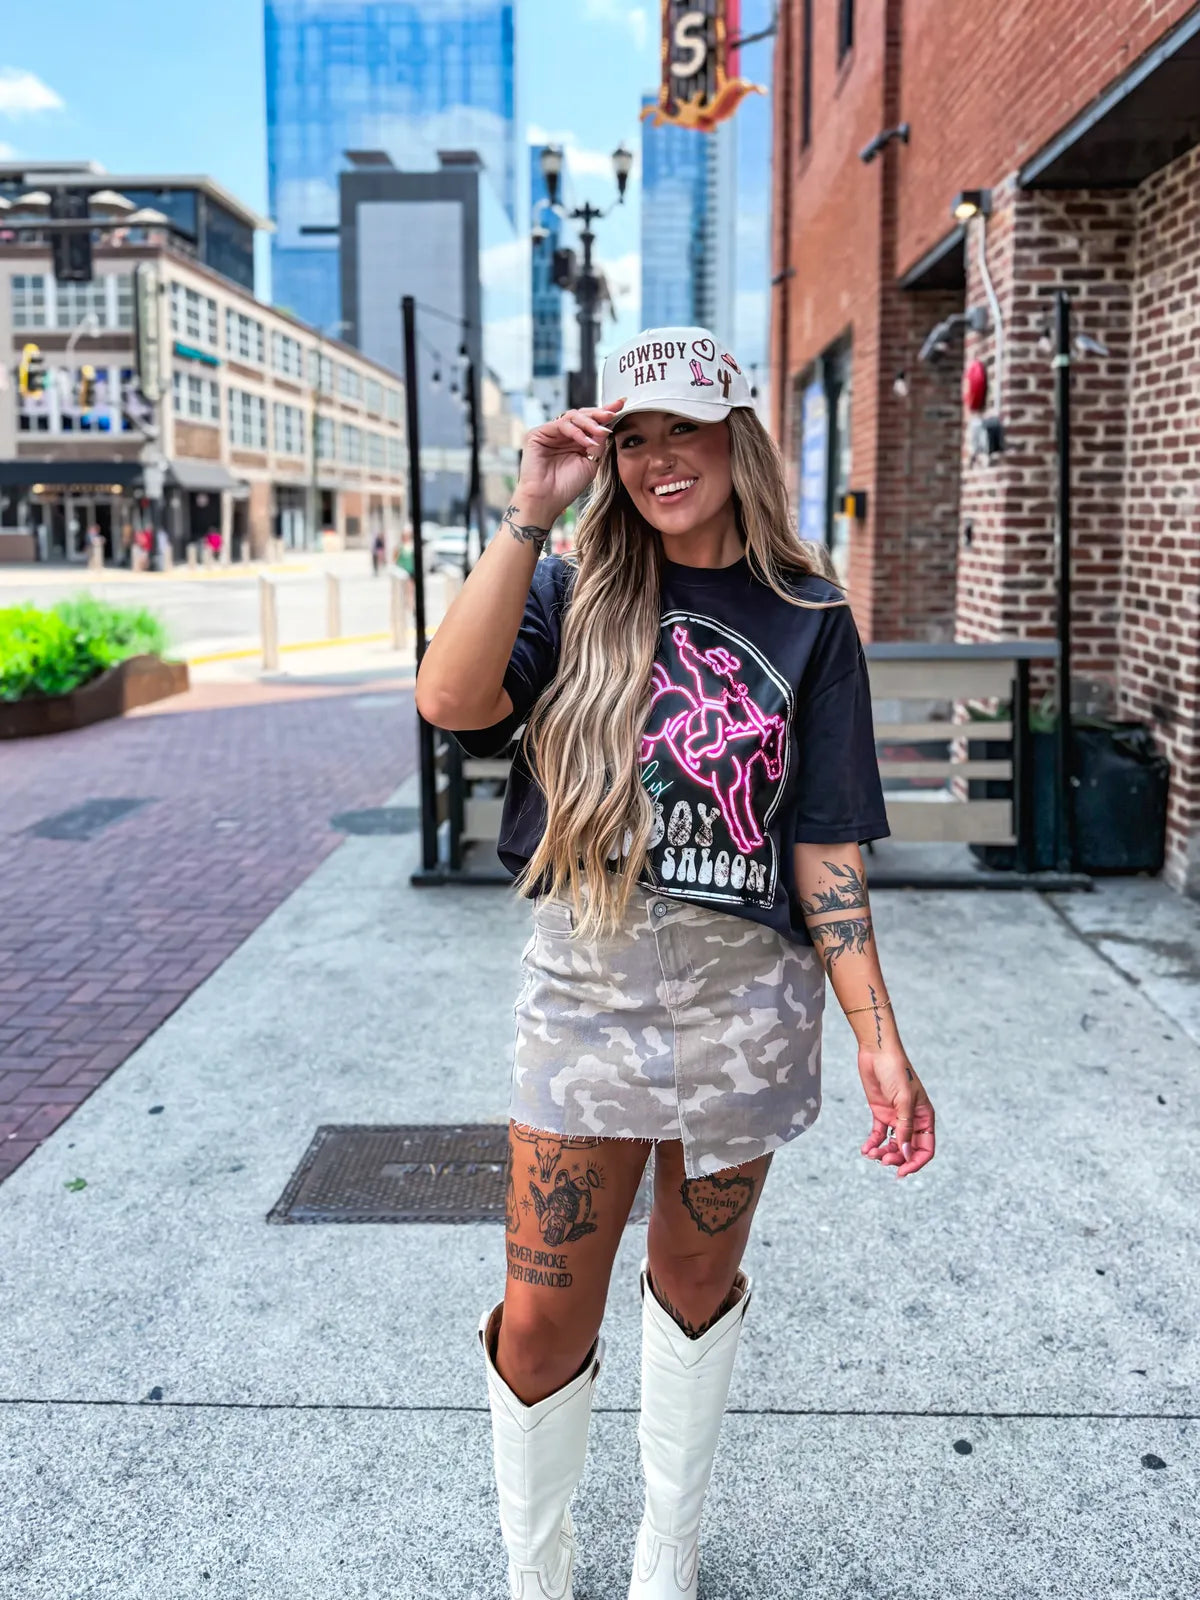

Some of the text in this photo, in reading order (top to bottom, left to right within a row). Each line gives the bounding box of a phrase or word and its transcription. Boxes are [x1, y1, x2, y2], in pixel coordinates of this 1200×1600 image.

[619, 341, 687, 374] COWBOY
[634, 362, 668, 387] HAT
[661, 847, 767, 893] SALOON
[508, 1240, 568, 1269] NEVER BROKE
[524, 1267, 573, 1288] BRANDED
